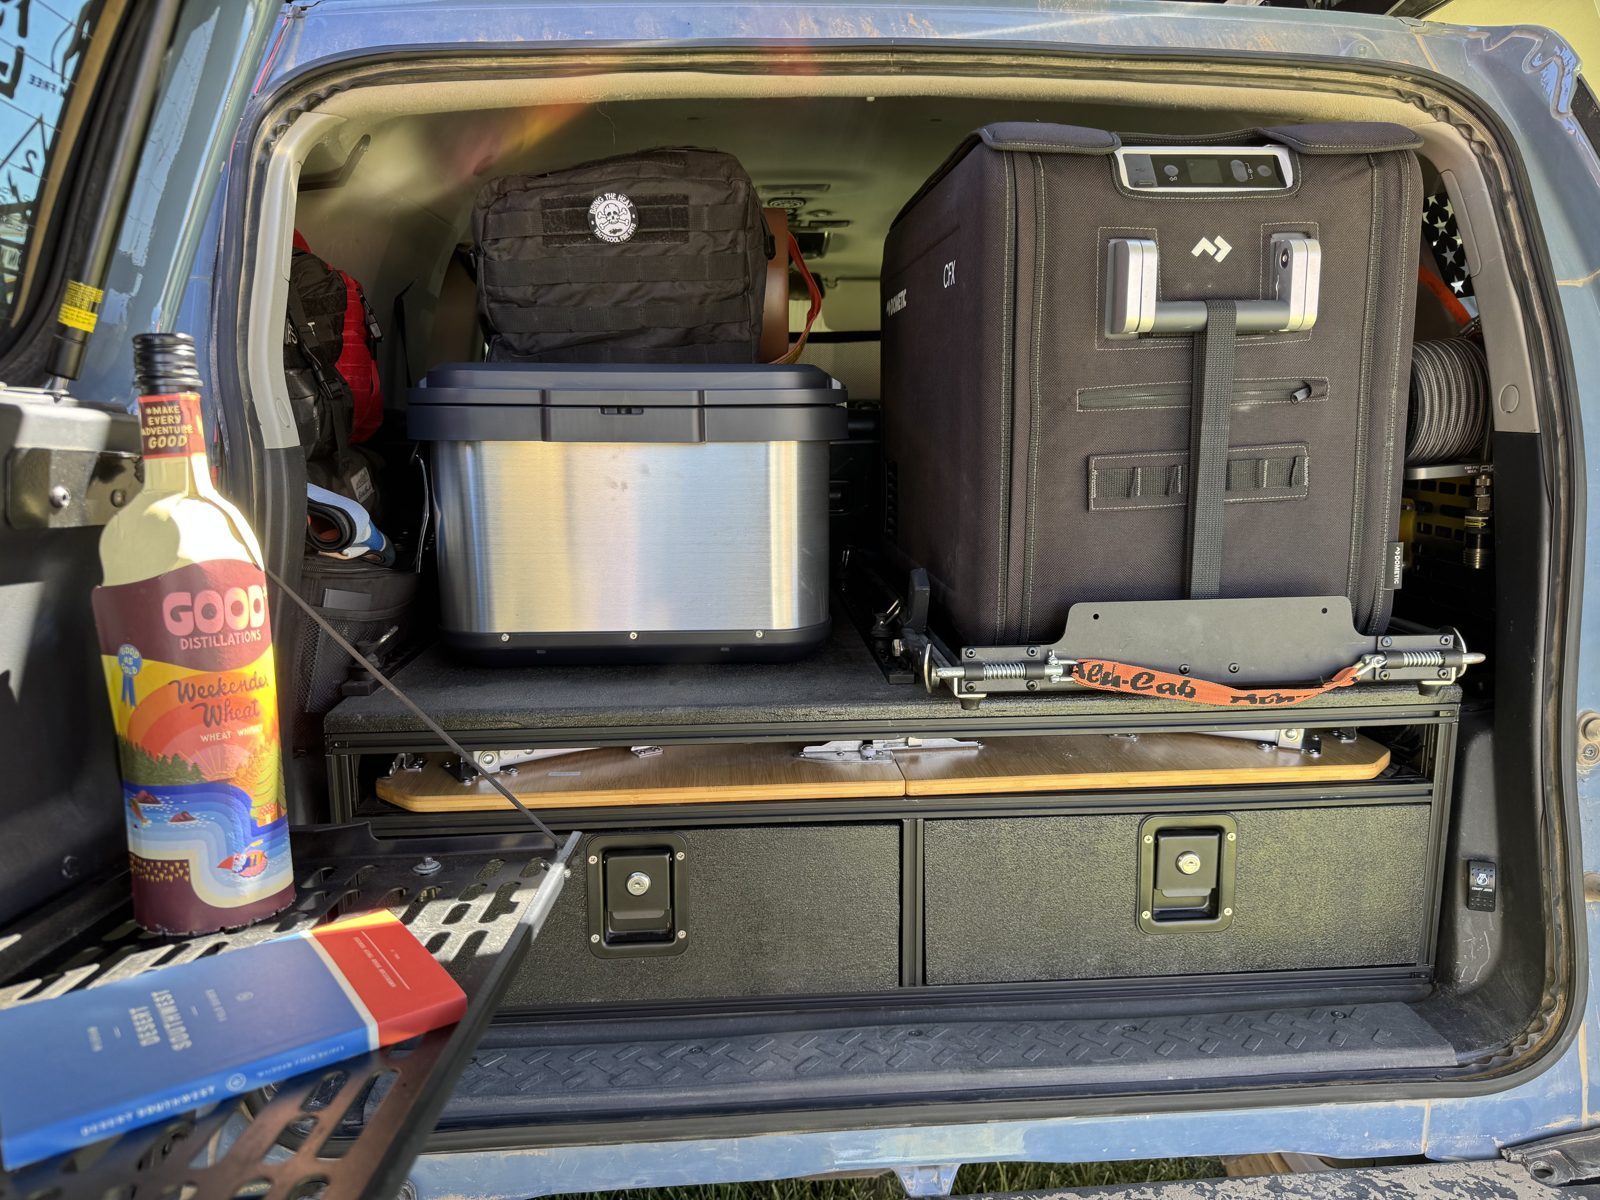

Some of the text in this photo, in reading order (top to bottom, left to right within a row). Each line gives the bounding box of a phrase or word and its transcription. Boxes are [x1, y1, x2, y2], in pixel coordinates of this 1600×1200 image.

[590, 197, 604, 215] BRING
[618, 194, 633, 208] HEAT
[943, 259, 957, 289] CFX
[141, 424, 193, 437] ADVENTURE
[147, 414, 182, 426] EVERY
[148, 435, 188, 449] GOOD
[1393, 555, 1401, 585] DOMETIC
[162, 585, 265, 636] GOOD
[180, 629, 262, 651] DISTILLATIONS
[191, 698, 261, 728] Wheat
[200, 730, 232, 743] WHEAT
[129, 1006, 161, 1048] DESERT
[151, 989, 193, 1051] SOUTHWEST
